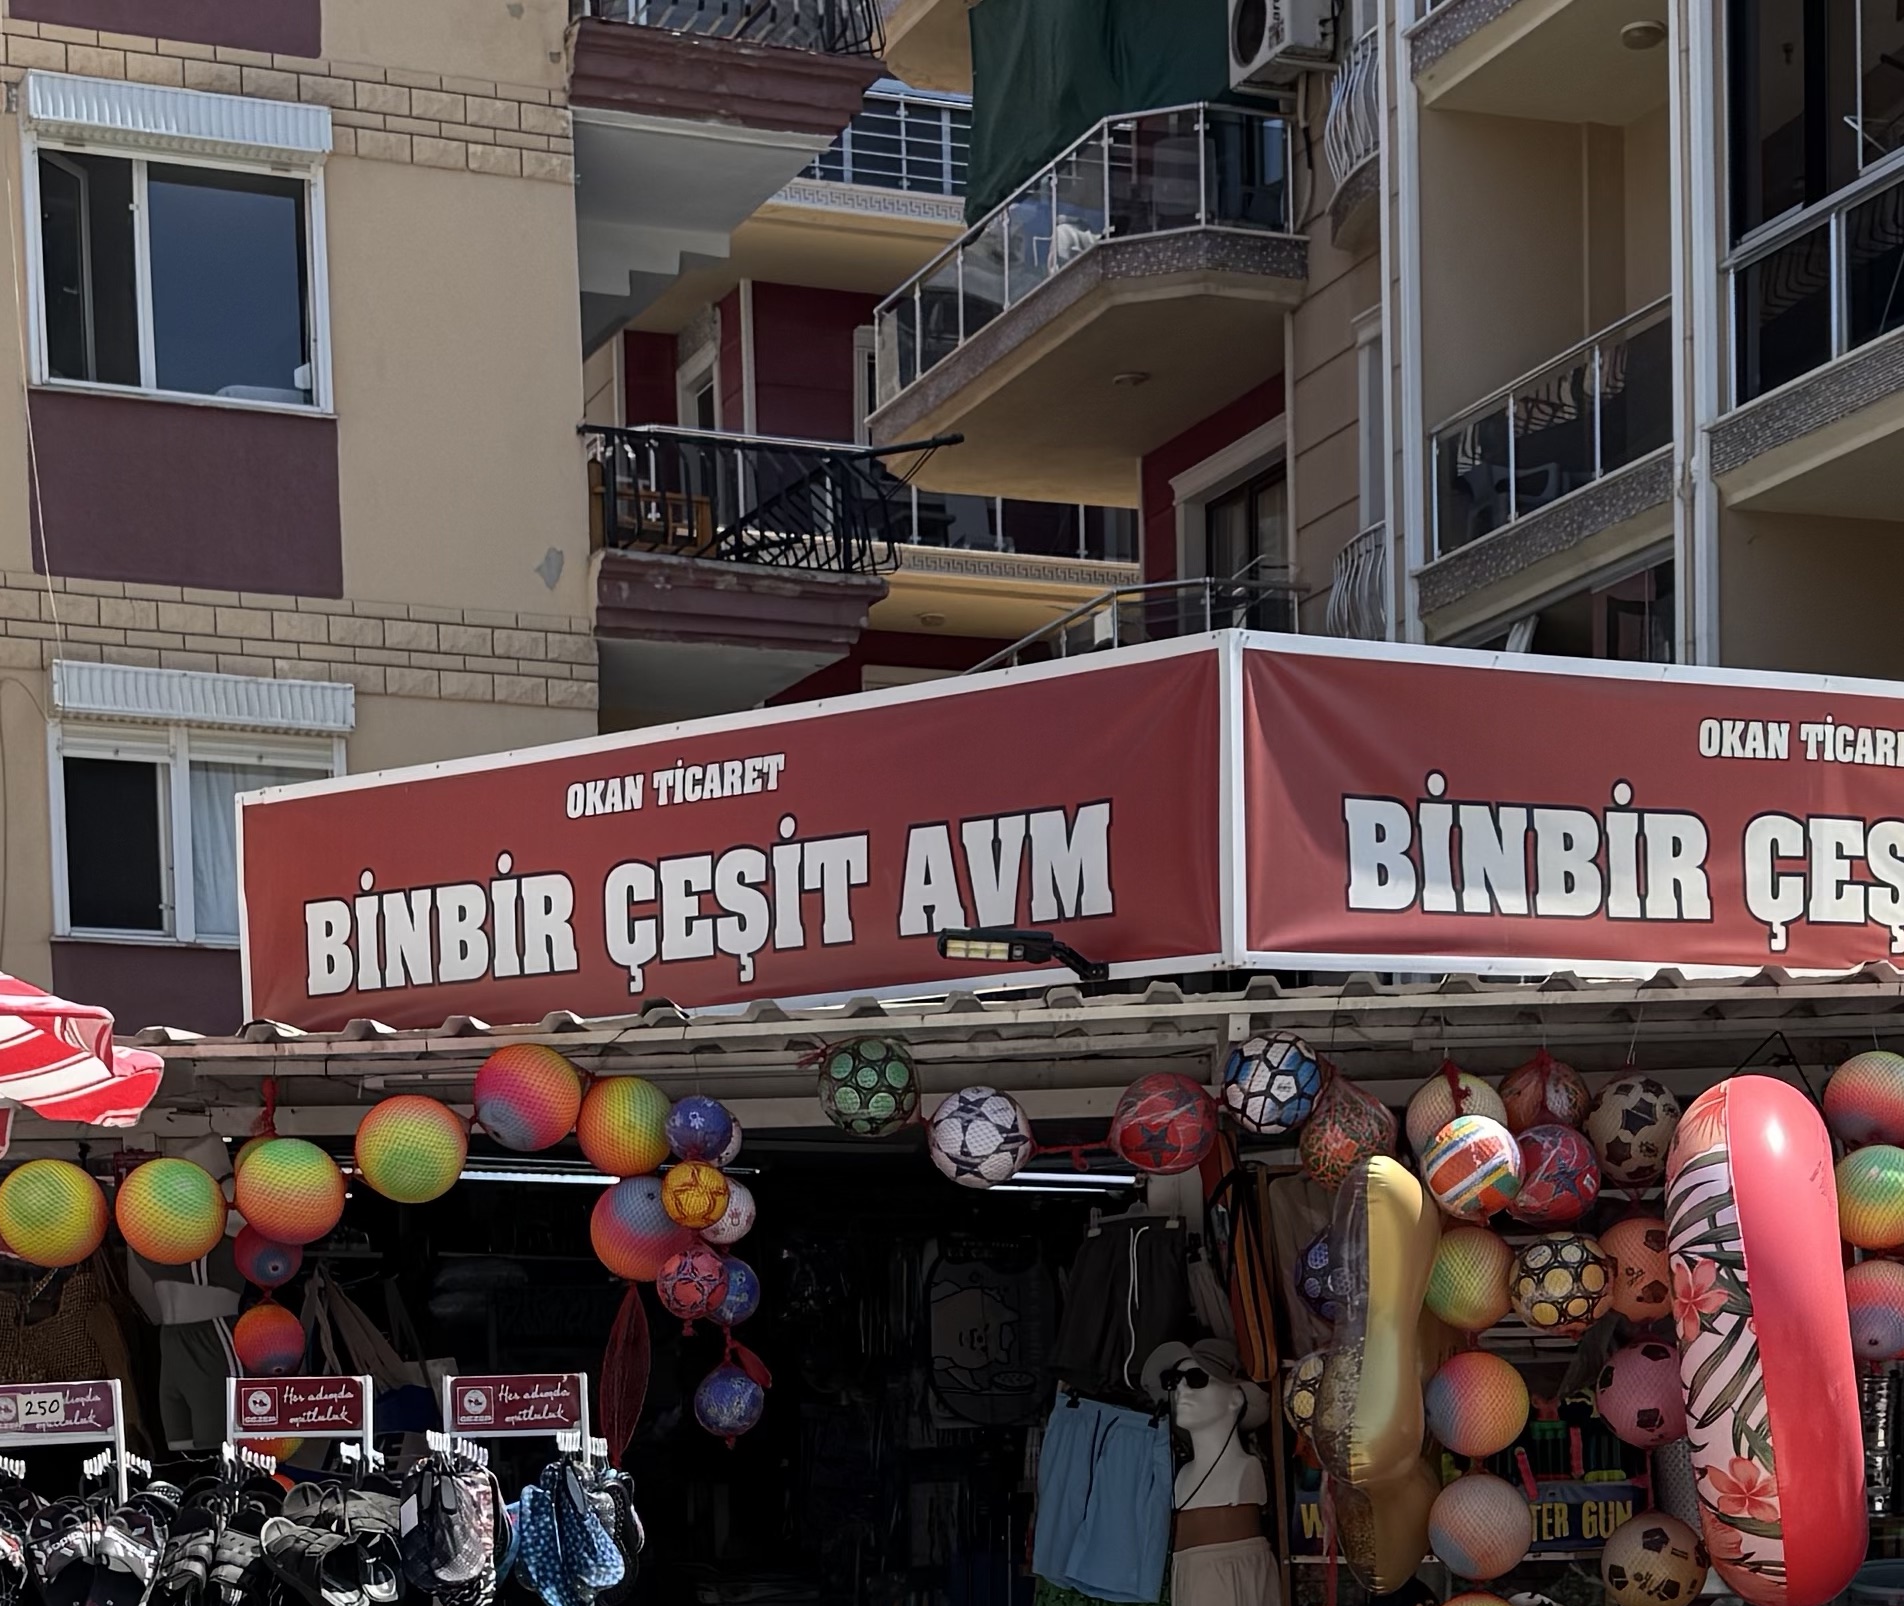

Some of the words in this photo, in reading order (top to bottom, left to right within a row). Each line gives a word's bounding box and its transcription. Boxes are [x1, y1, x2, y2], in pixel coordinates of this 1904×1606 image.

[1698, 716, 1789, 761] OKAN
[566, 773, 644, 819] OKAN
[652, 753, 786, 807] TİCARET
[1342, 769, 1714, 922] BİNBİR
[304, 850, 580, 998] BİNBİR
[604, 813, 870, 995] ÇEŞİT
[898, 799, 1115, 938] AVM
[24, 1399, 61, 1416] 250
[1529, 1501, 1570, 1543] TER
[1581, 1499, 1634, 1541] GUN
